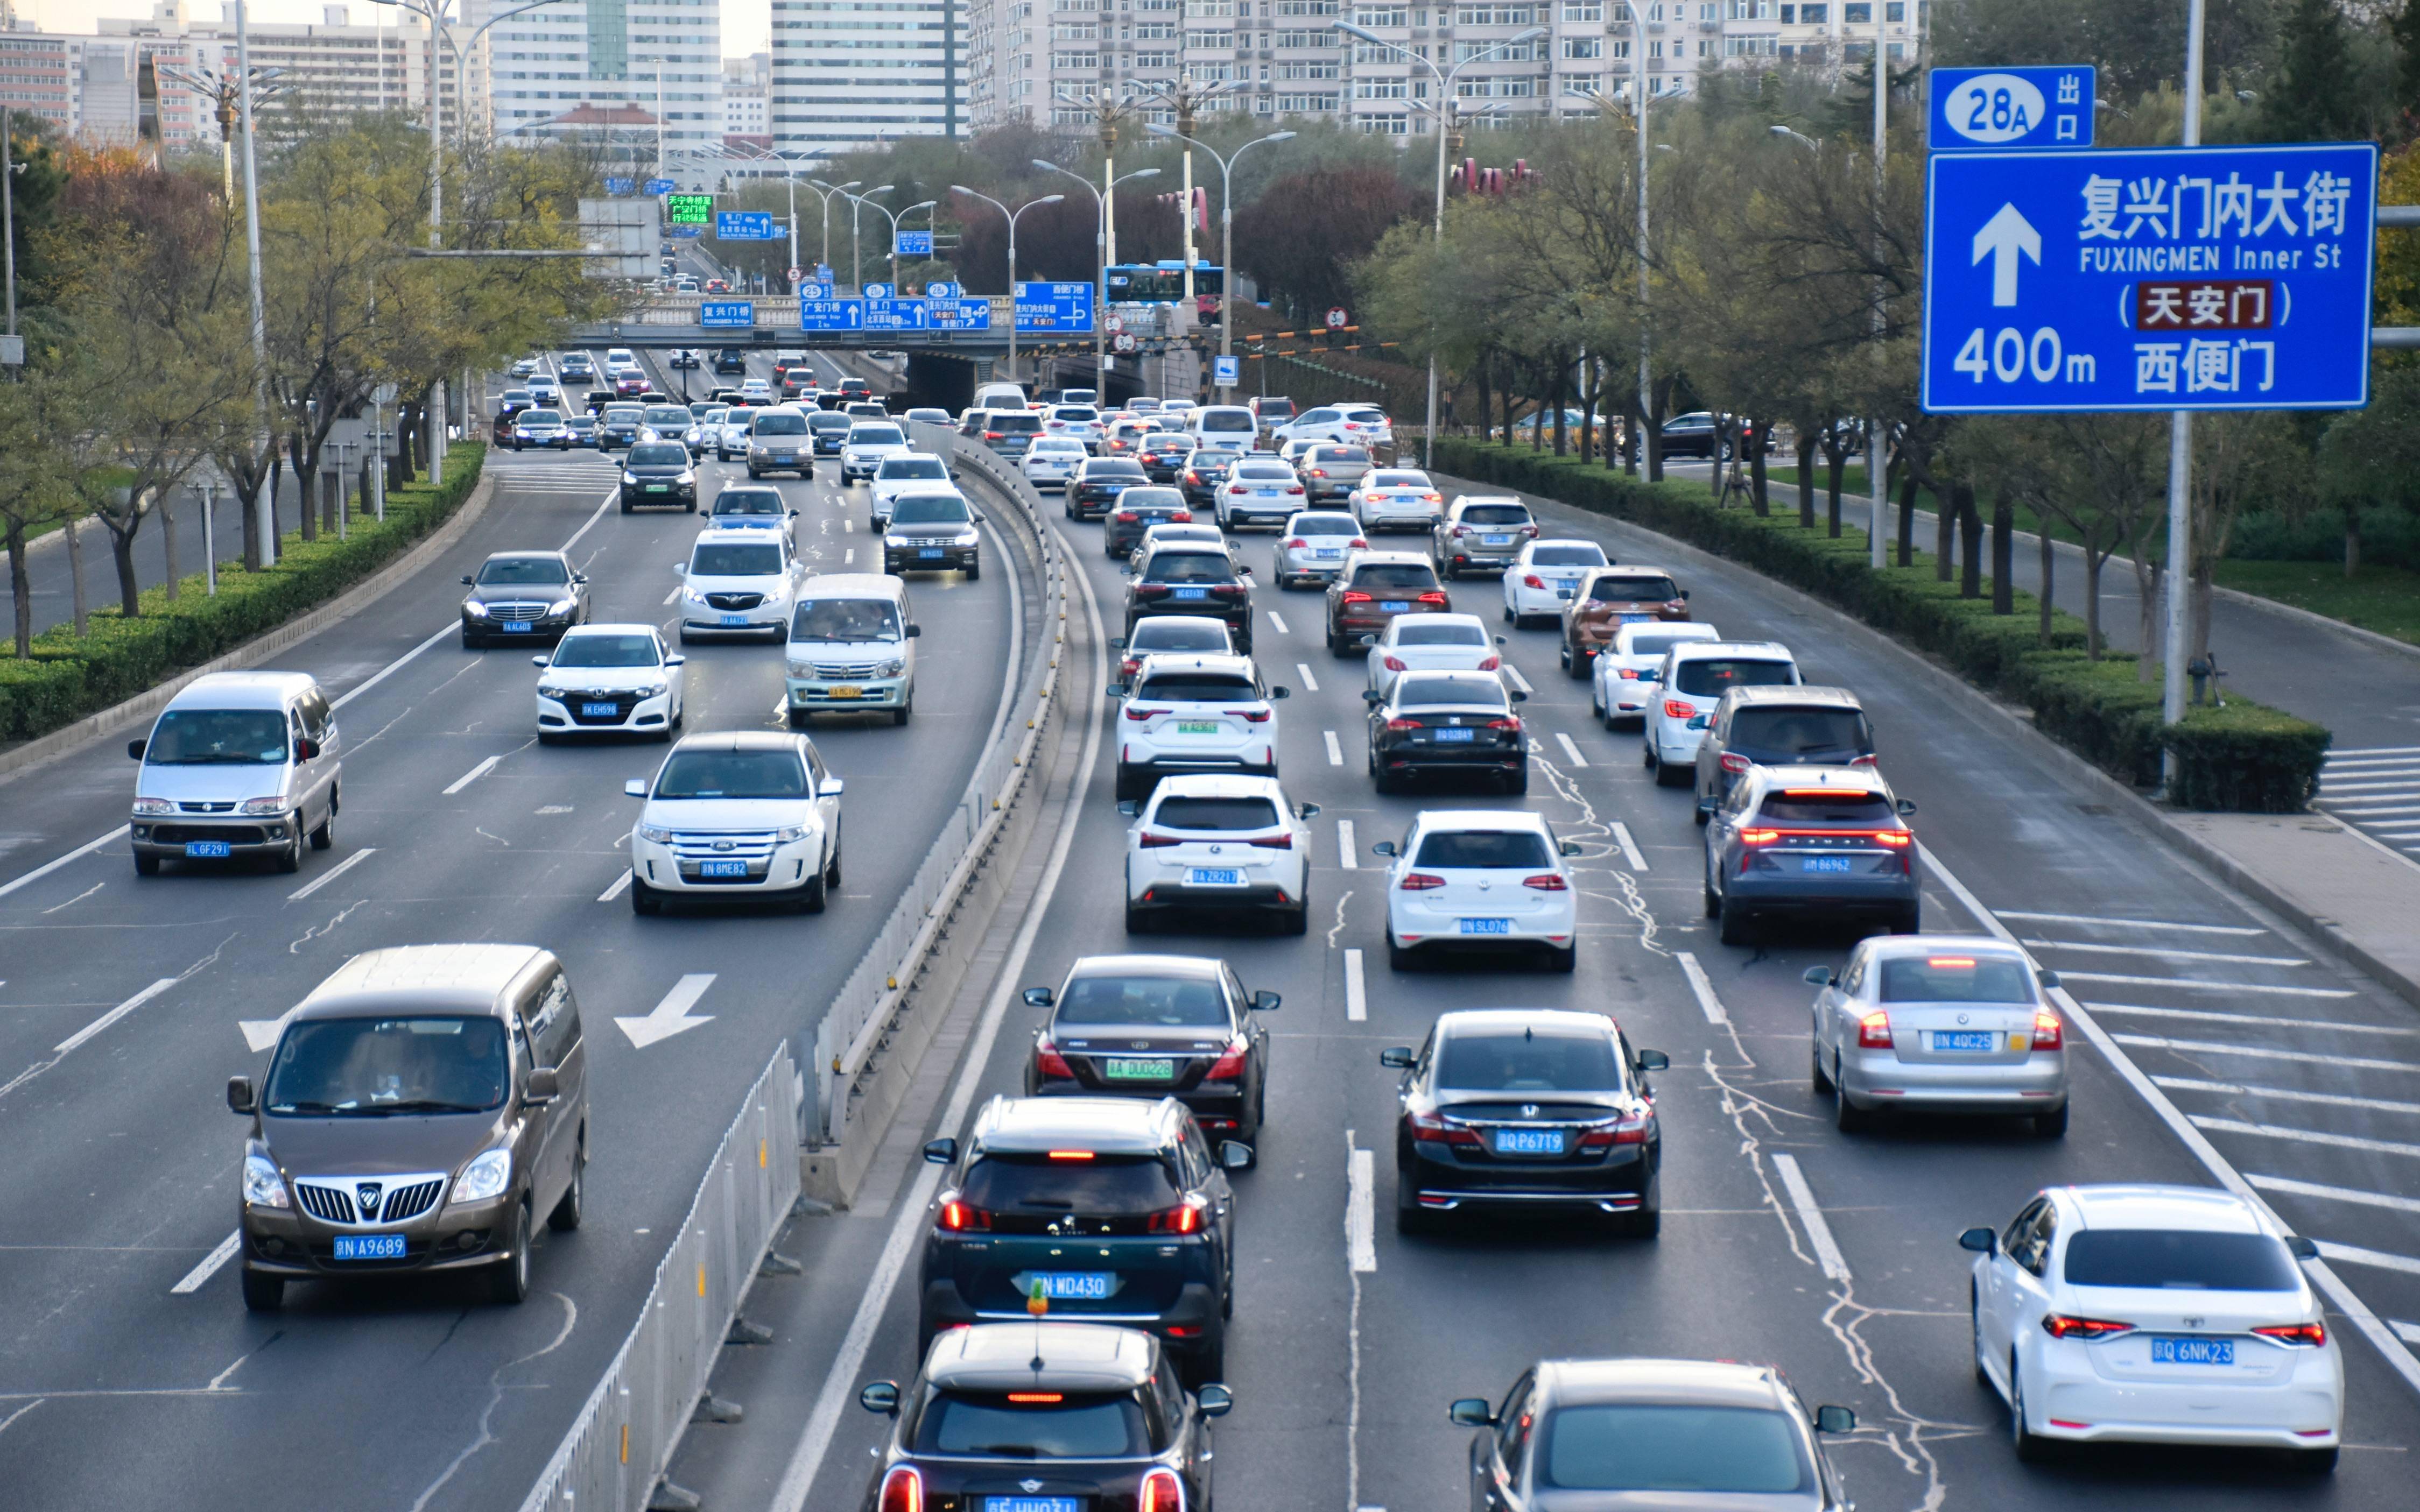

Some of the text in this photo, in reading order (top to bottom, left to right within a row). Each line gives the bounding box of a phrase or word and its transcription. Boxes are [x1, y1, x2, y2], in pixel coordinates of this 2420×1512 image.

[1968, 88, 2029, 132] 28A
[2057, 74, 2080, 140] 出口
[2079, 171, 2351, 240] 复兴门内大街
[2081, 243, 2342, 273] FUXINGMEN Inner St
[806, 287, 818, 295] 25
[933, 286, 945, 294] 28A
[1053, 285, 1085, 294] 西便门桥
[704, 306, 749, 317] 复兴门桥
[804, 302, 841, 313] 广安门桥
[1954, 327, 2096, 383] 400m
[2134, 338, 2275, 393] 西便门
